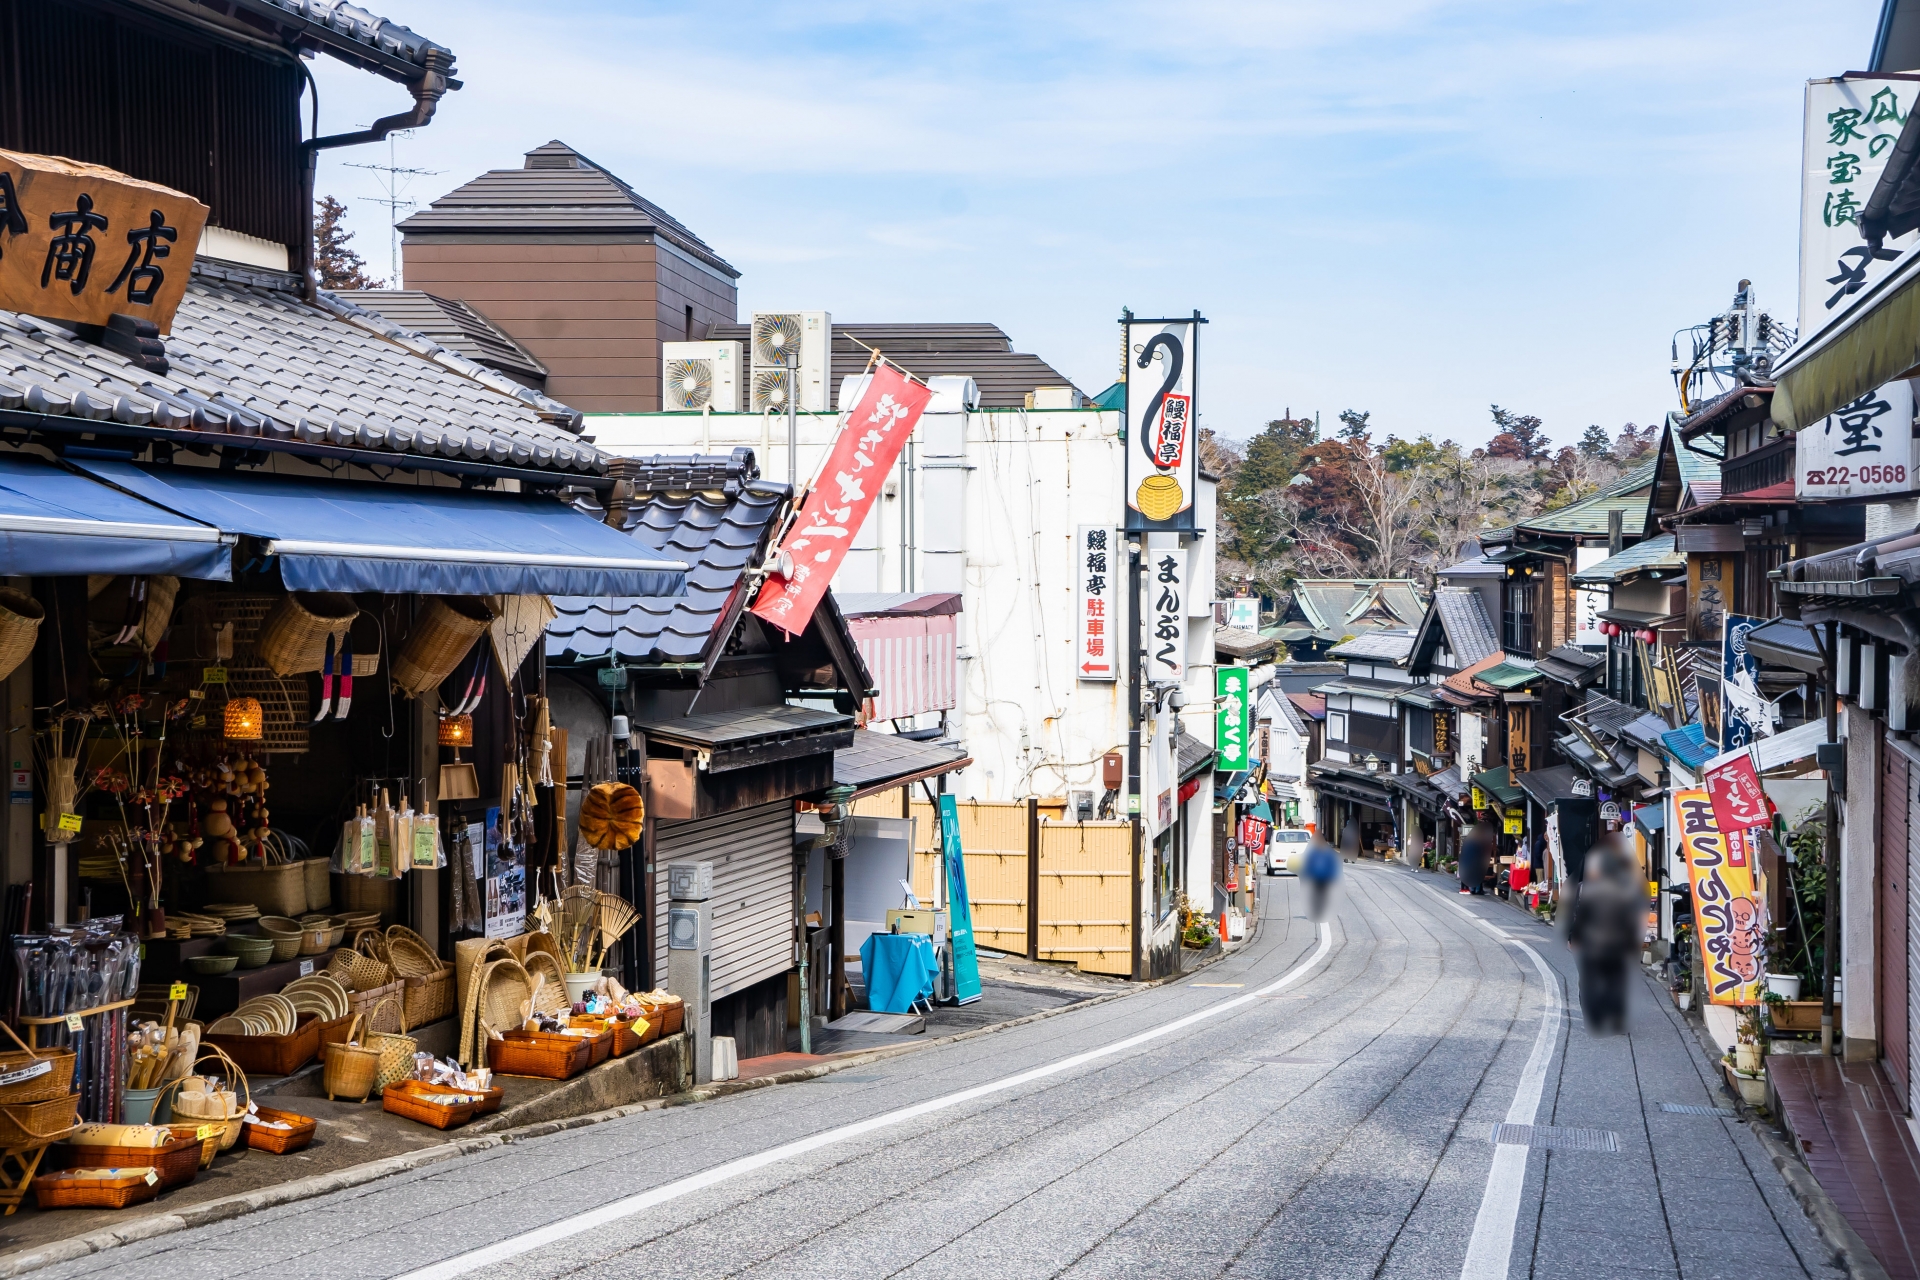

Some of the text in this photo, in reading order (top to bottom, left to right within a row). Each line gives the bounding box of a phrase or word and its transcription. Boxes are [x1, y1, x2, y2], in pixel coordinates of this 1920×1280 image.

[1823, 106, 1868, 228] 家宝漬
[1158, 398, 1185, 463] 鰻福亭
[1825, 390, 1892, 457] 堂
[1826, 464, 1906, 485] 22-0568
[1154, 554, 1180, 671] まんぷく
[1586, 583, 1599, 631] んさま
